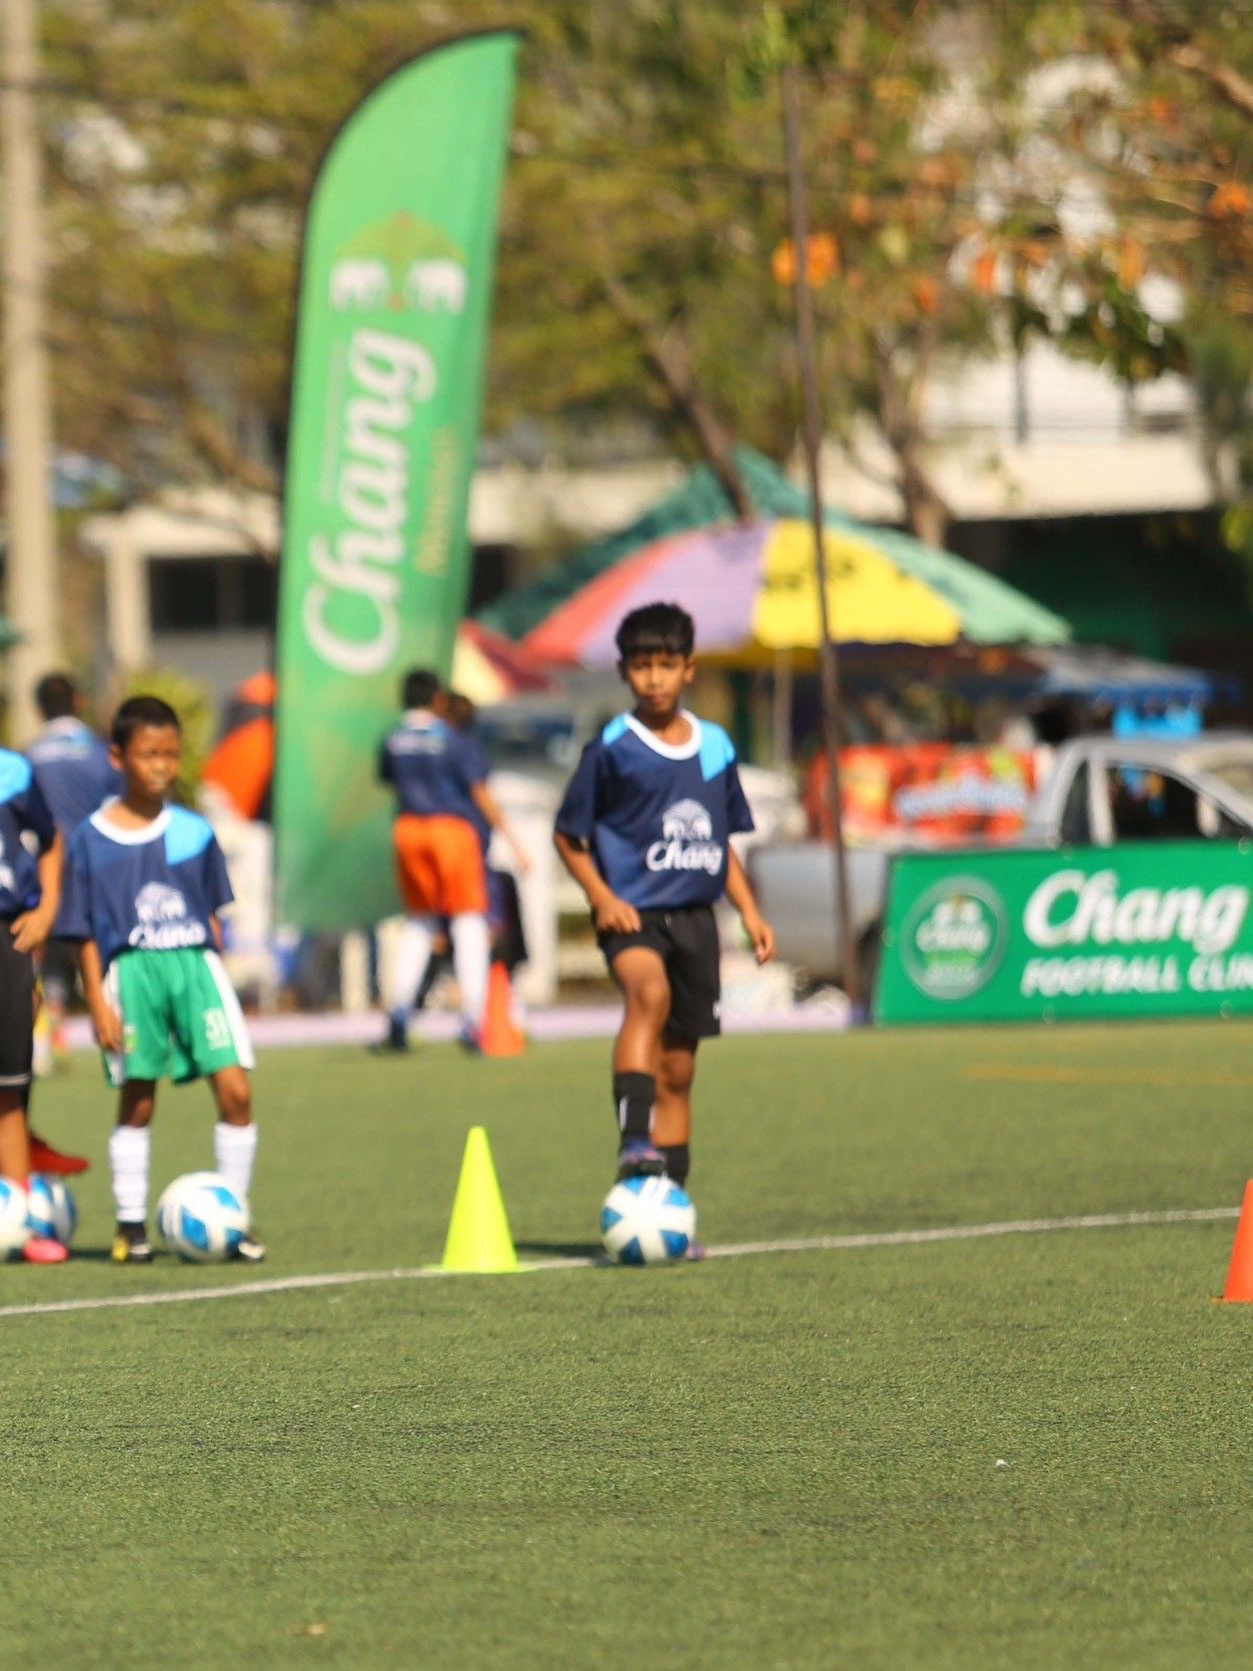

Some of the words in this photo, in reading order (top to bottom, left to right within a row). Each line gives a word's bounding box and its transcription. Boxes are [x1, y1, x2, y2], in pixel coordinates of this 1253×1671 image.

[303, 327, 438, 675] Chang
[646, 837, 723, 876] Chang
[1022, 869, 1249, 955] Chang
[1020, 954, 1181, 998] FOOTBALL
